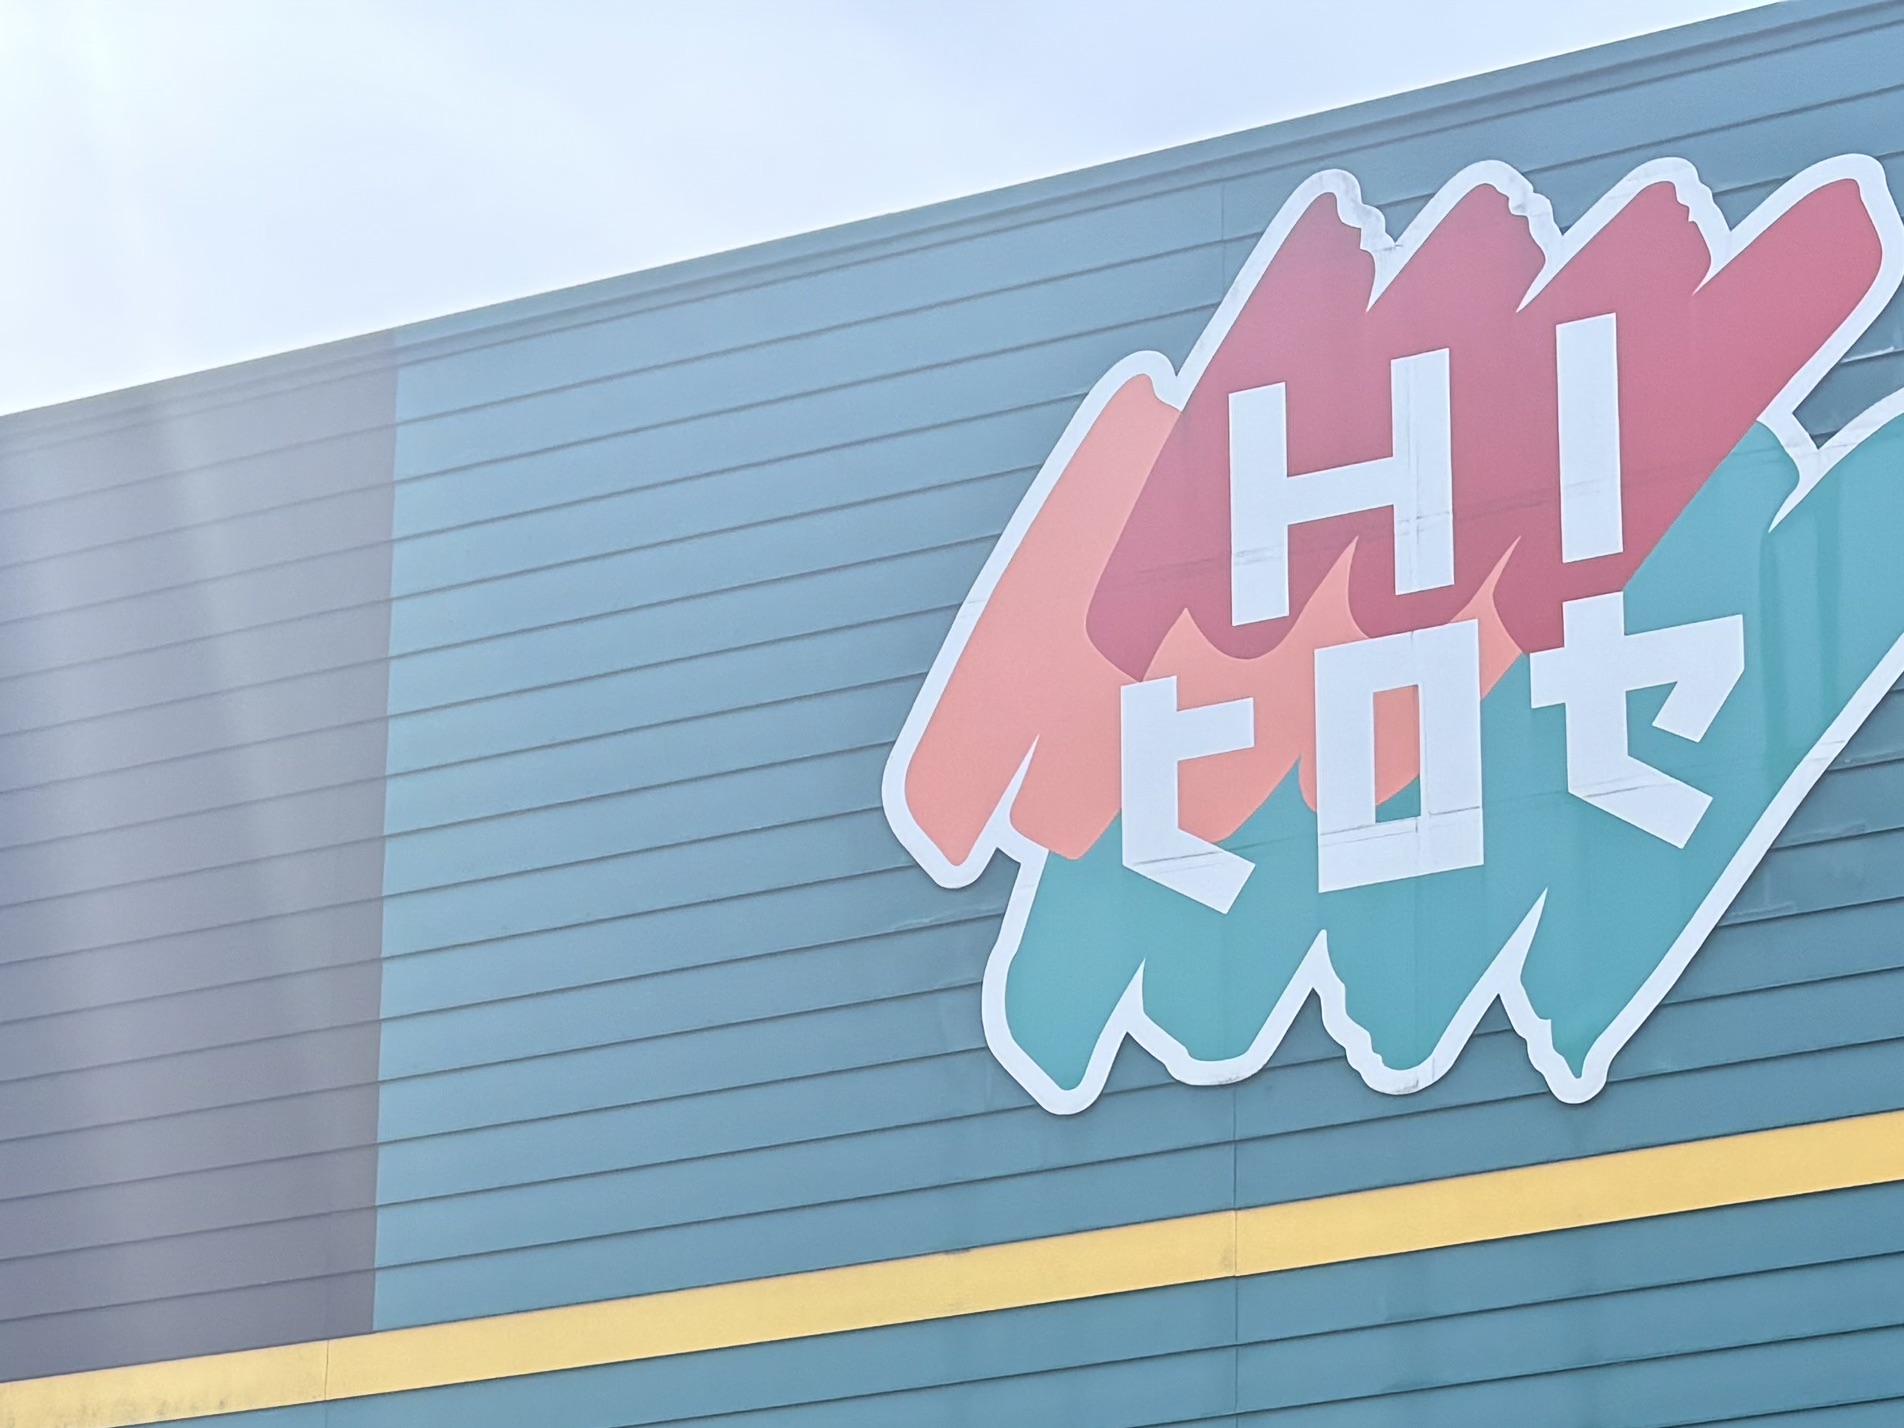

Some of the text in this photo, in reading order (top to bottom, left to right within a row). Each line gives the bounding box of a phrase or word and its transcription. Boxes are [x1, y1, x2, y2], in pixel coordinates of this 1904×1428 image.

[1229, 311, 1623, 626] HI
[1121, 591, 1745, 914] ヒロセ
